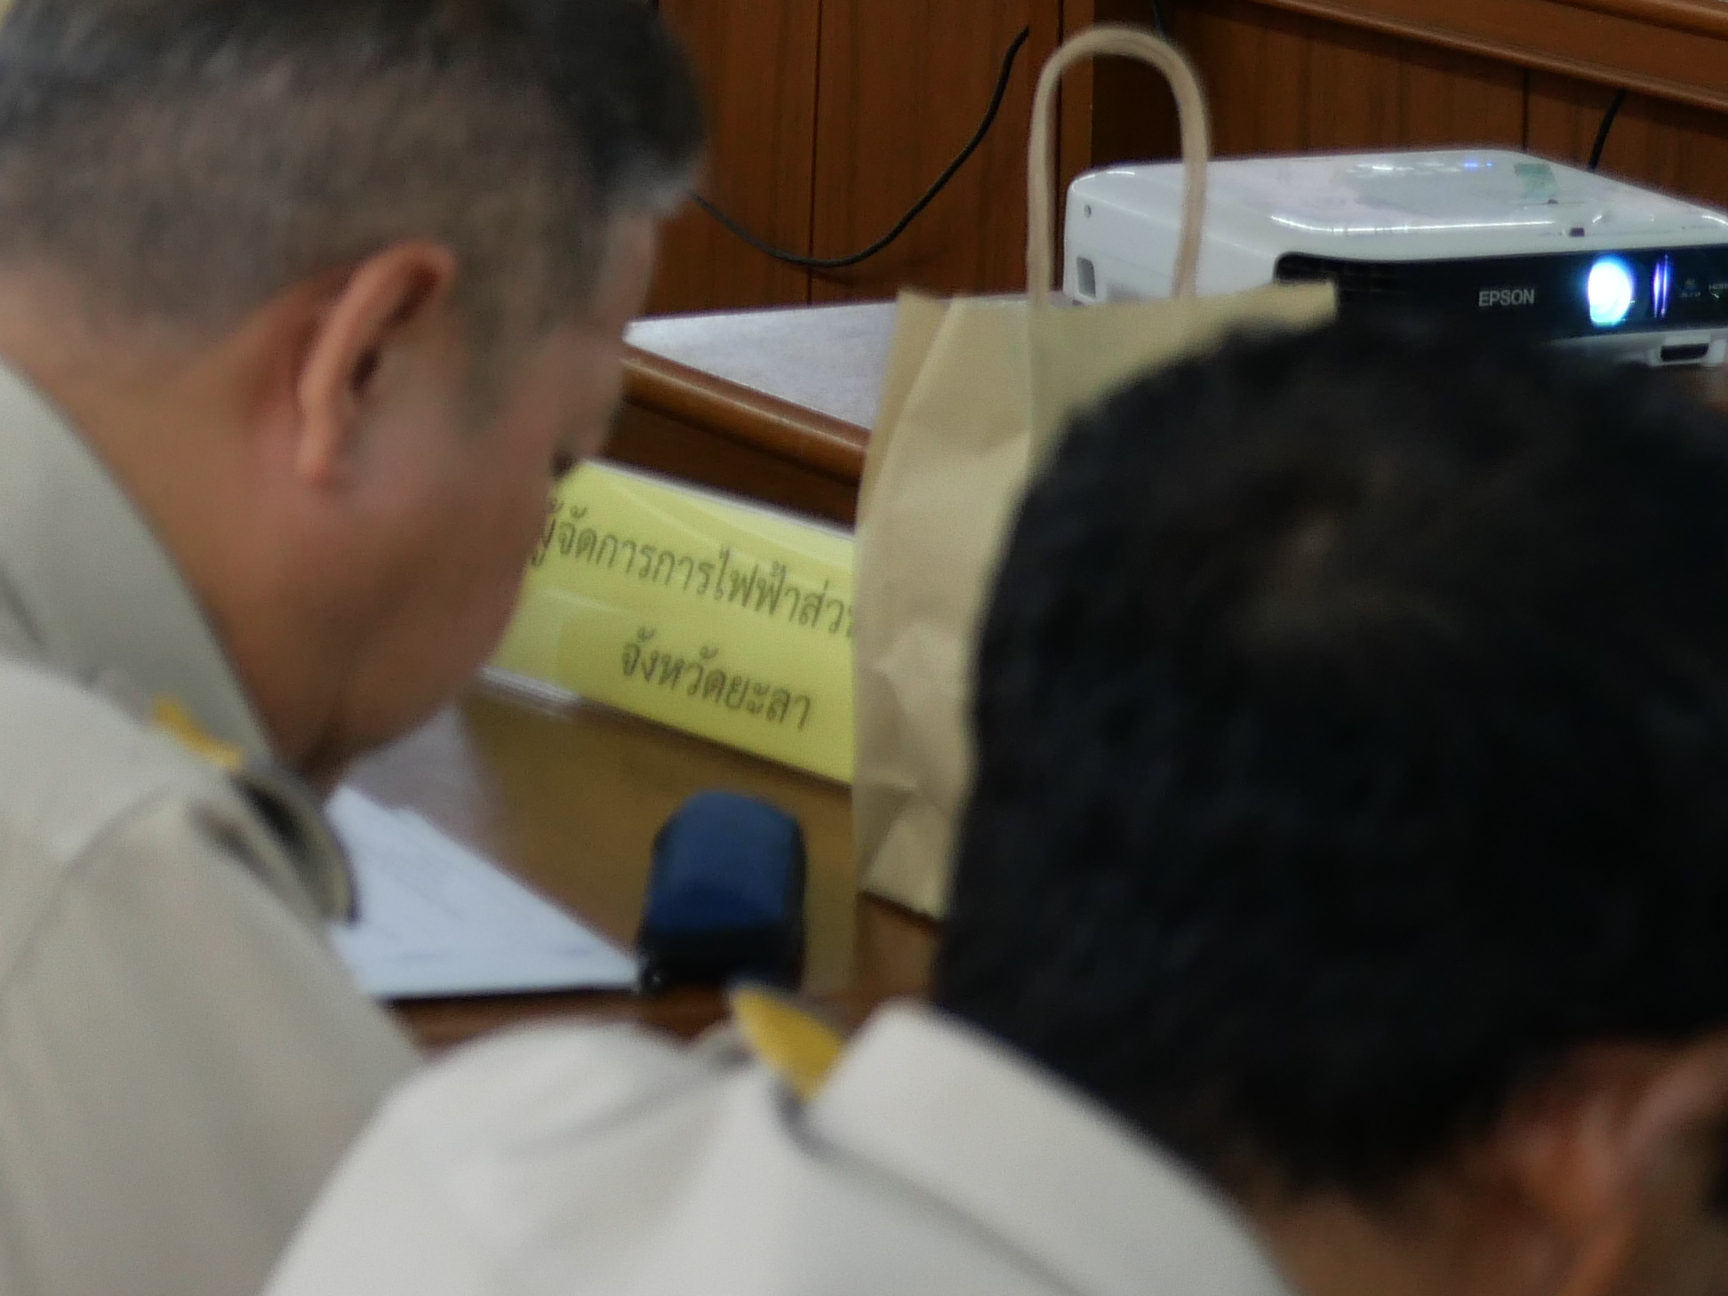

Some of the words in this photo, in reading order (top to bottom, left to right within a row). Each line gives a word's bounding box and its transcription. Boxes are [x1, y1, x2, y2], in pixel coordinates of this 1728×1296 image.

[1478, 289, 1535, 307] EPSON
[531, 497, 853, 638] ู้จัดการการไฟฟ้าส่ว
[621, 627, 811, 732] จังหวัดยะลา
